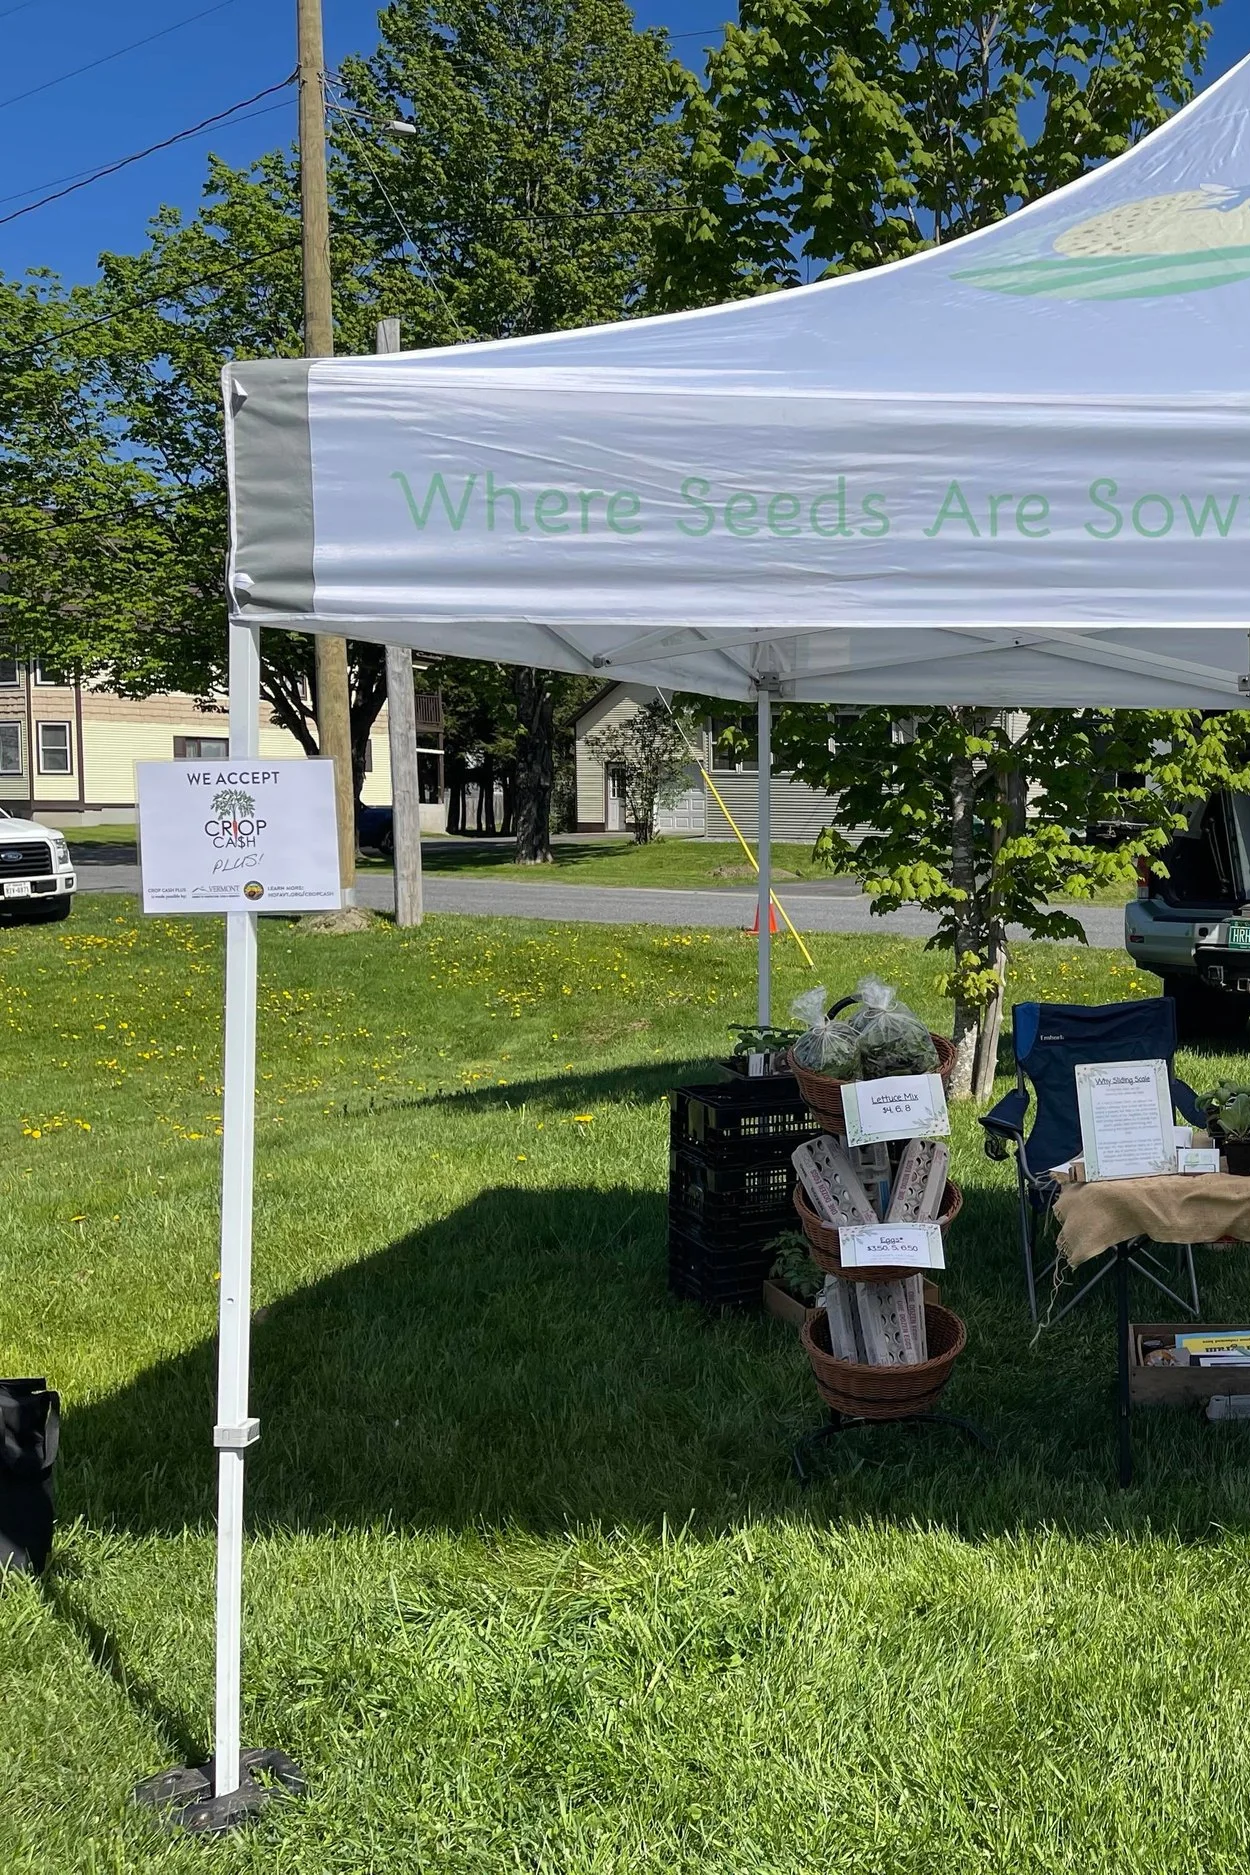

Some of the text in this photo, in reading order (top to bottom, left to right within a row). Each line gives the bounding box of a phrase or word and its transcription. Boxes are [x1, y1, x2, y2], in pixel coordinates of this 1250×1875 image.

[390, 471, 643, 533] Where
[676, 476, 891, 538] Seeds
[923, 479, 1051, 538] Are
[187, 771, 280, 785] WE ACCEPT
[204, 819, 267, 837] CROP
[212, 852, 264, 875] PLUS!
[1095, 1075, 1151, 1087] Why Sliding Scale
[871, 1092, 919, 1105] Lettuce Mix
[905, 1104, 912, 1112] 8
